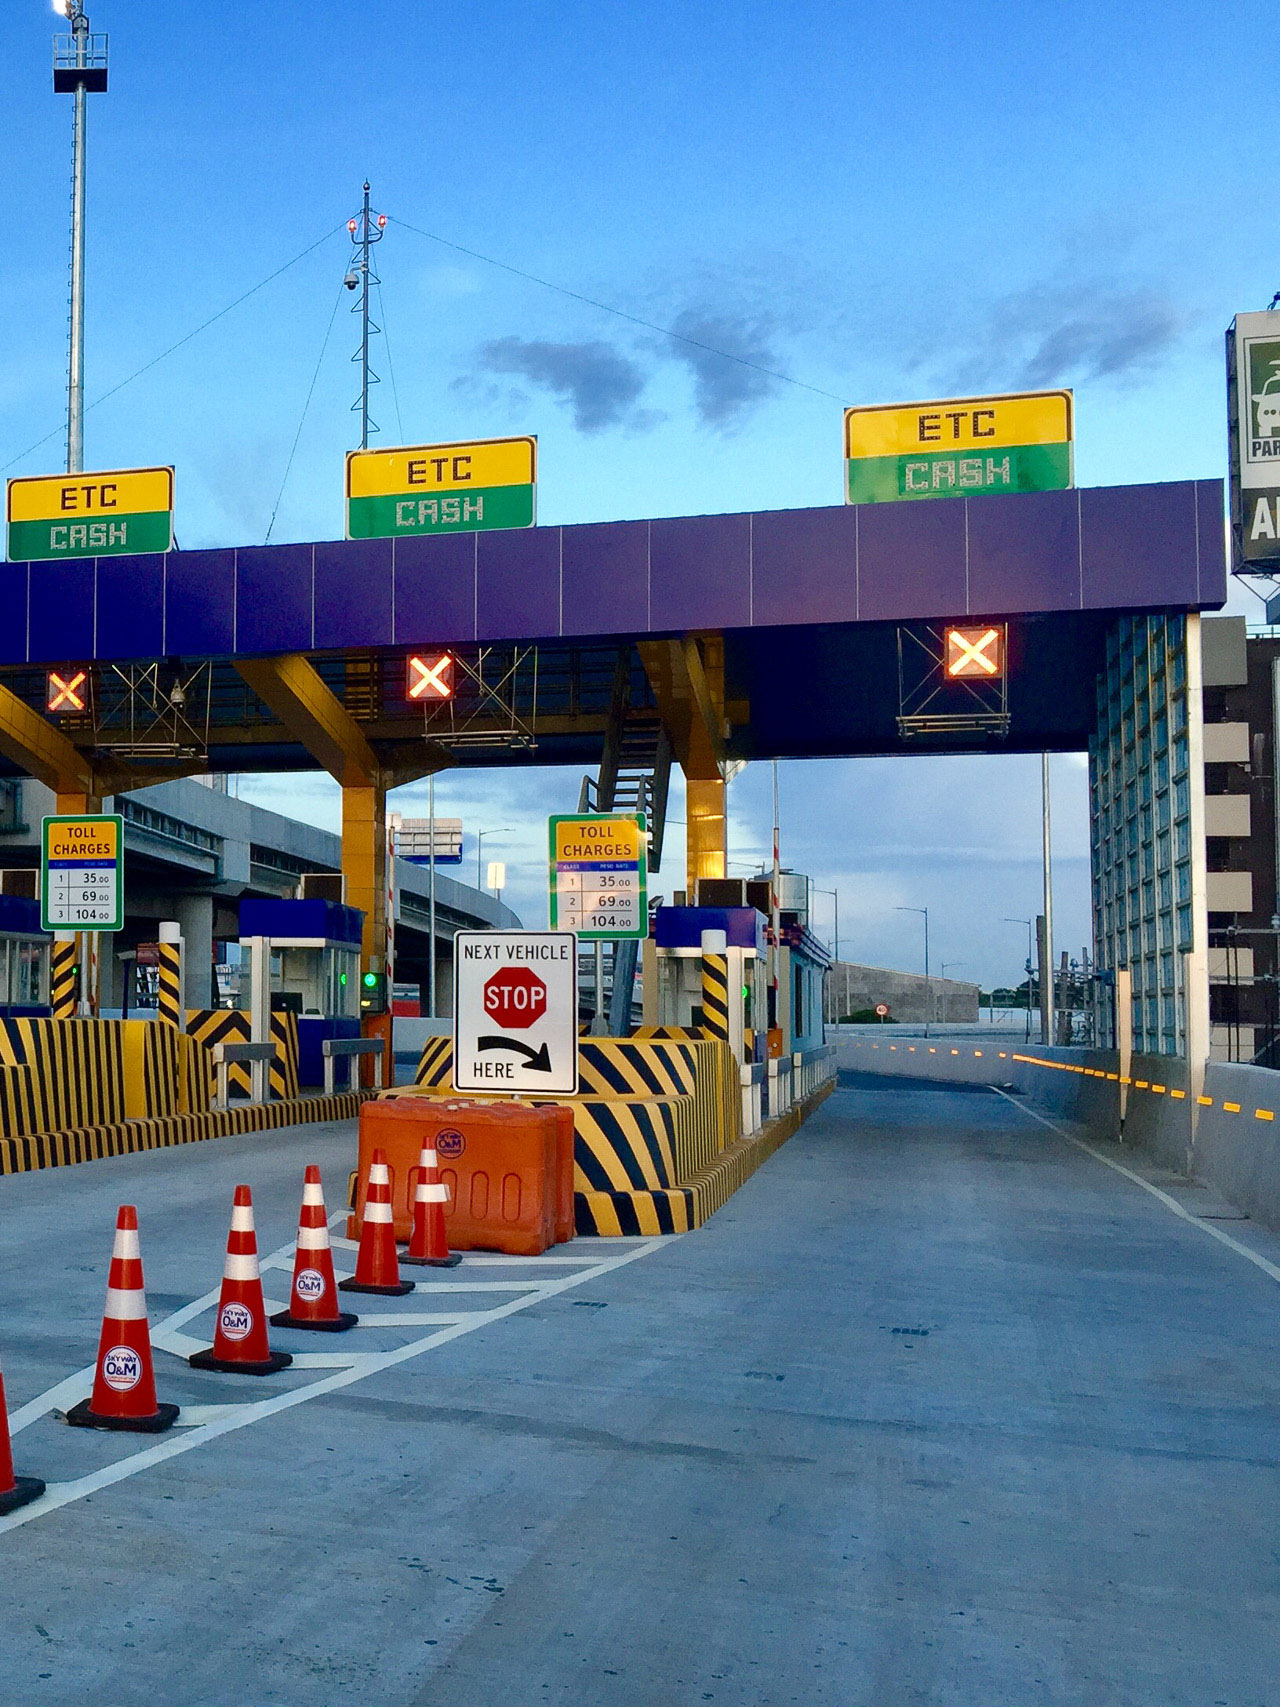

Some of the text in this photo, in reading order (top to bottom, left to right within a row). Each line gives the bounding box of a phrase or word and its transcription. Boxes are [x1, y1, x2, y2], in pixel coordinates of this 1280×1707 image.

[918, 409, 995, 441] ETC
[407, 455, 472, 484] ETC
[905, 455, 1011, 492] CASH
[60, 484, 117, 510] ETC
[395, 496, 484, 527] CASH
[1250, 496, 1280, 540] A
[50, 521, 127, 550] CASH
[67, 827, 96, 838] TOLL
[579, 826, 614, 838] TOLL
[53, 843, 110, 855] CHARGES
[563, 844, 632, 857] CHARGES
[599, 876, 631, 887] 35.00
[570, 895, 631, 907] 2 69.00
[570, 915, 632, 927] 3 104.00
[464, 944, 569, 960] NEXT VEHICLE
[485, 985, 545, 1010] STOP
[473, 1062, 515, 1079] HERE
[298, 1280, 321, 1291] O&M
[223, 1315, 248, 1328] O&M
[106, 1362, 137, 1376] O&M
